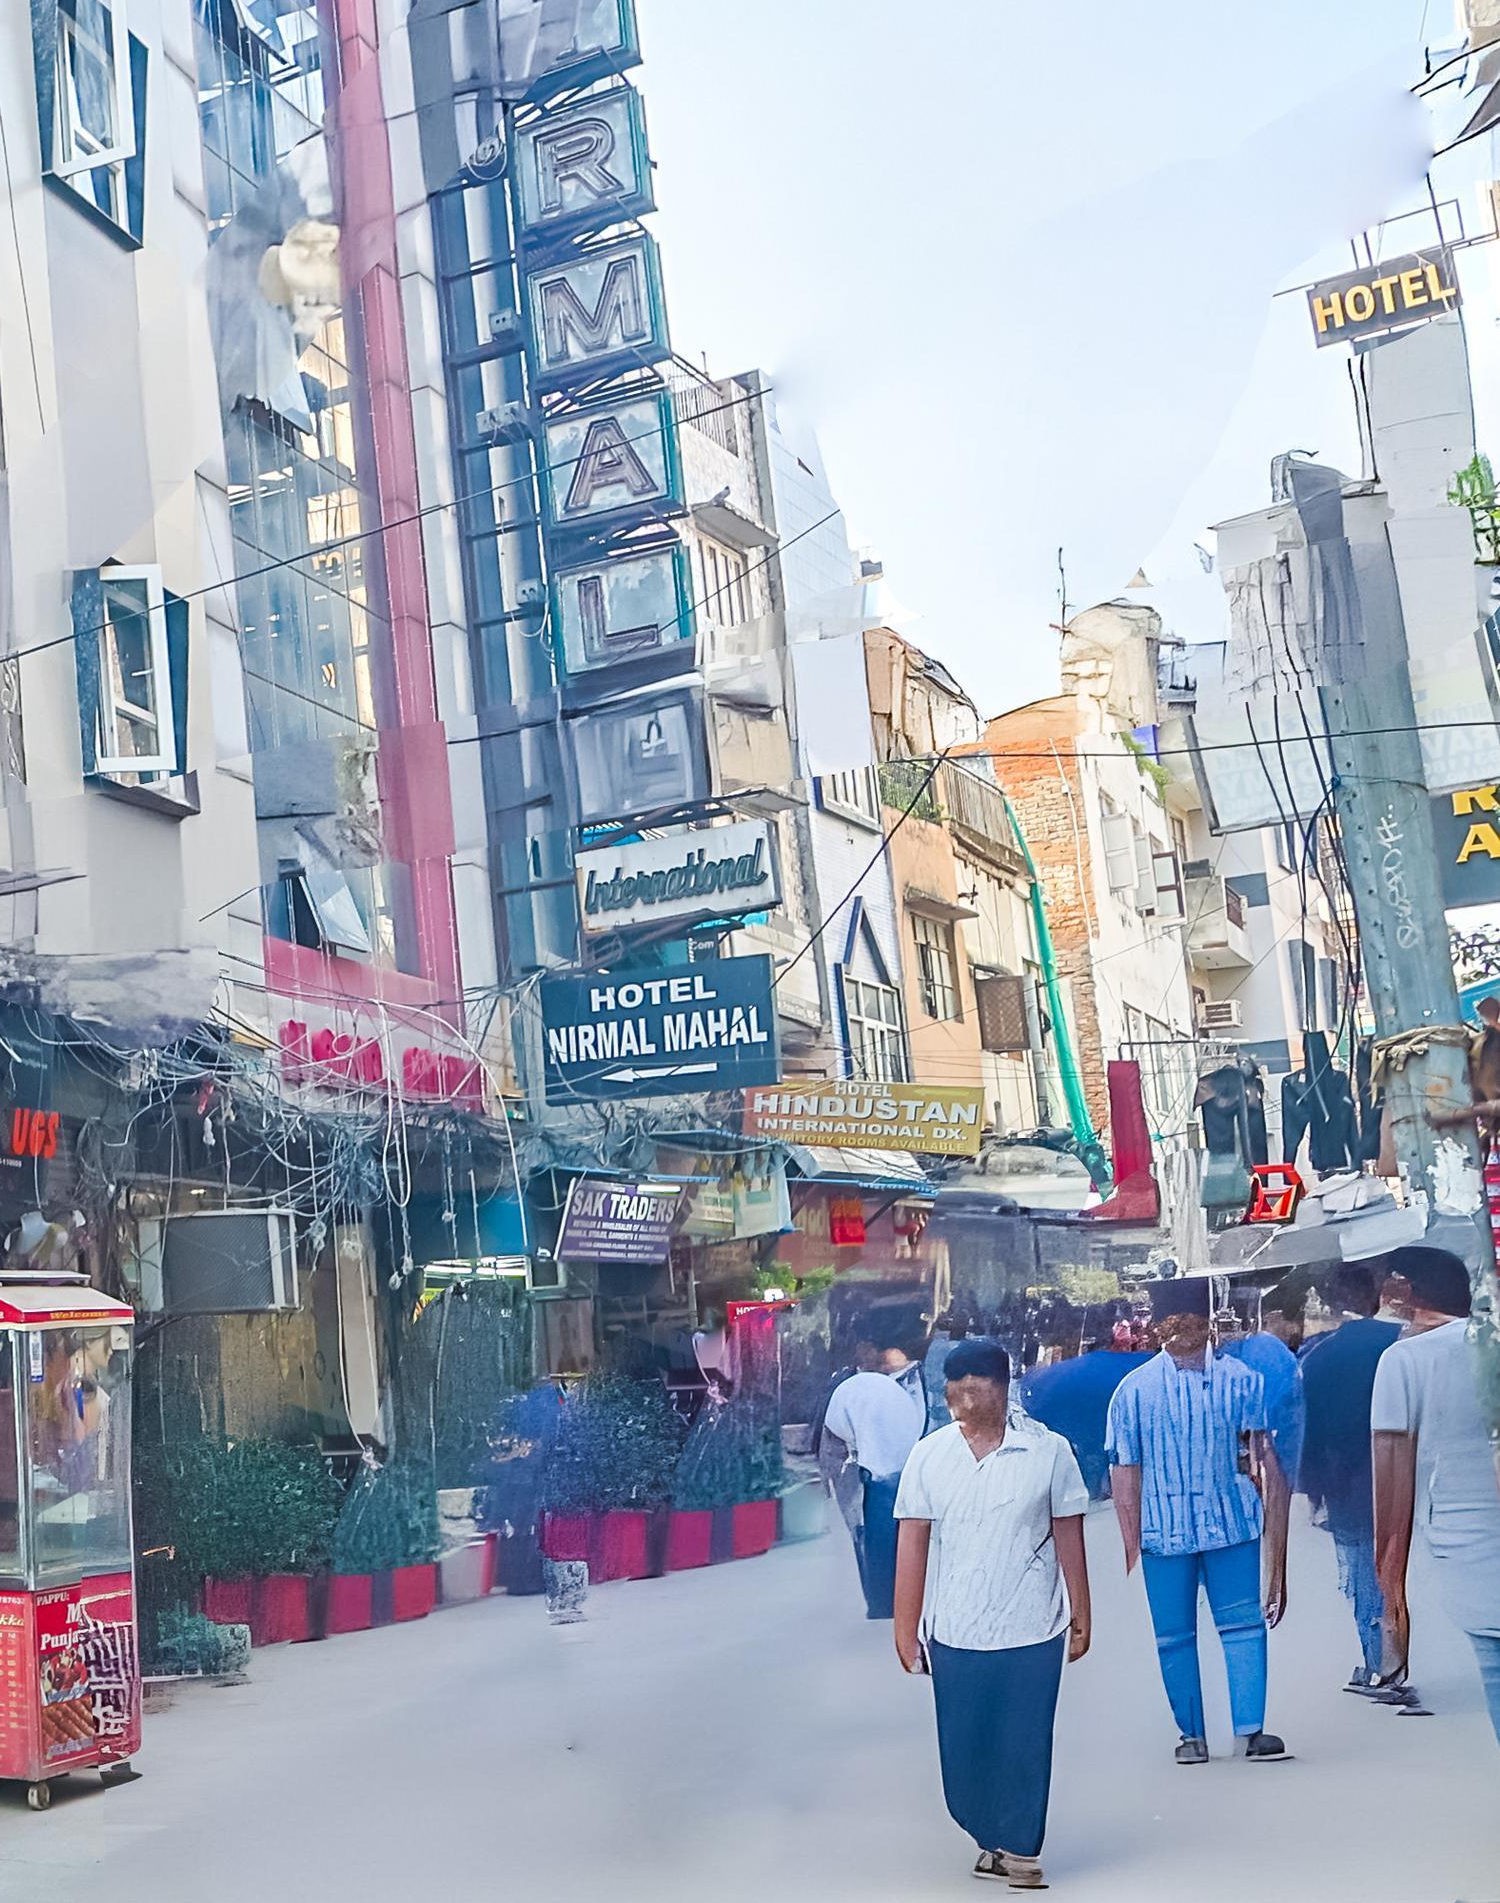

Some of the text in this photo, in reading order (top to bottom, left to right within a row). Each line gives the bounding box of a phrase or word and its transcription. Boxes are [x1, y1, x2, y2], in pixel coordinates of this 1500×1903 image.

[1312, 263, 1457, 334] HOTEL
[585, 837, 769, 915] International
[590, 975, 717, 1012] HOTEL
[549, 1017, 657, 1064] NIRMAL
[663, 1004, 769, 1053] MAHAL
[835, 1082, 893, 1097] HOTEL
[753, 1093, 979, 1125] HINDUSTAN
[757, 1117, 968, 1141] INTERNATIONAL DX.
[839, 1136, 886, 1147] ROOMS
[890, 1138, 966, 1152] AVAILABLE
[571, 1189, 677, 1224] SAK TRADERS
[50, 1311, 111, 1320] Welcome
[36, 1592, 70, 1607] PAPPU:
